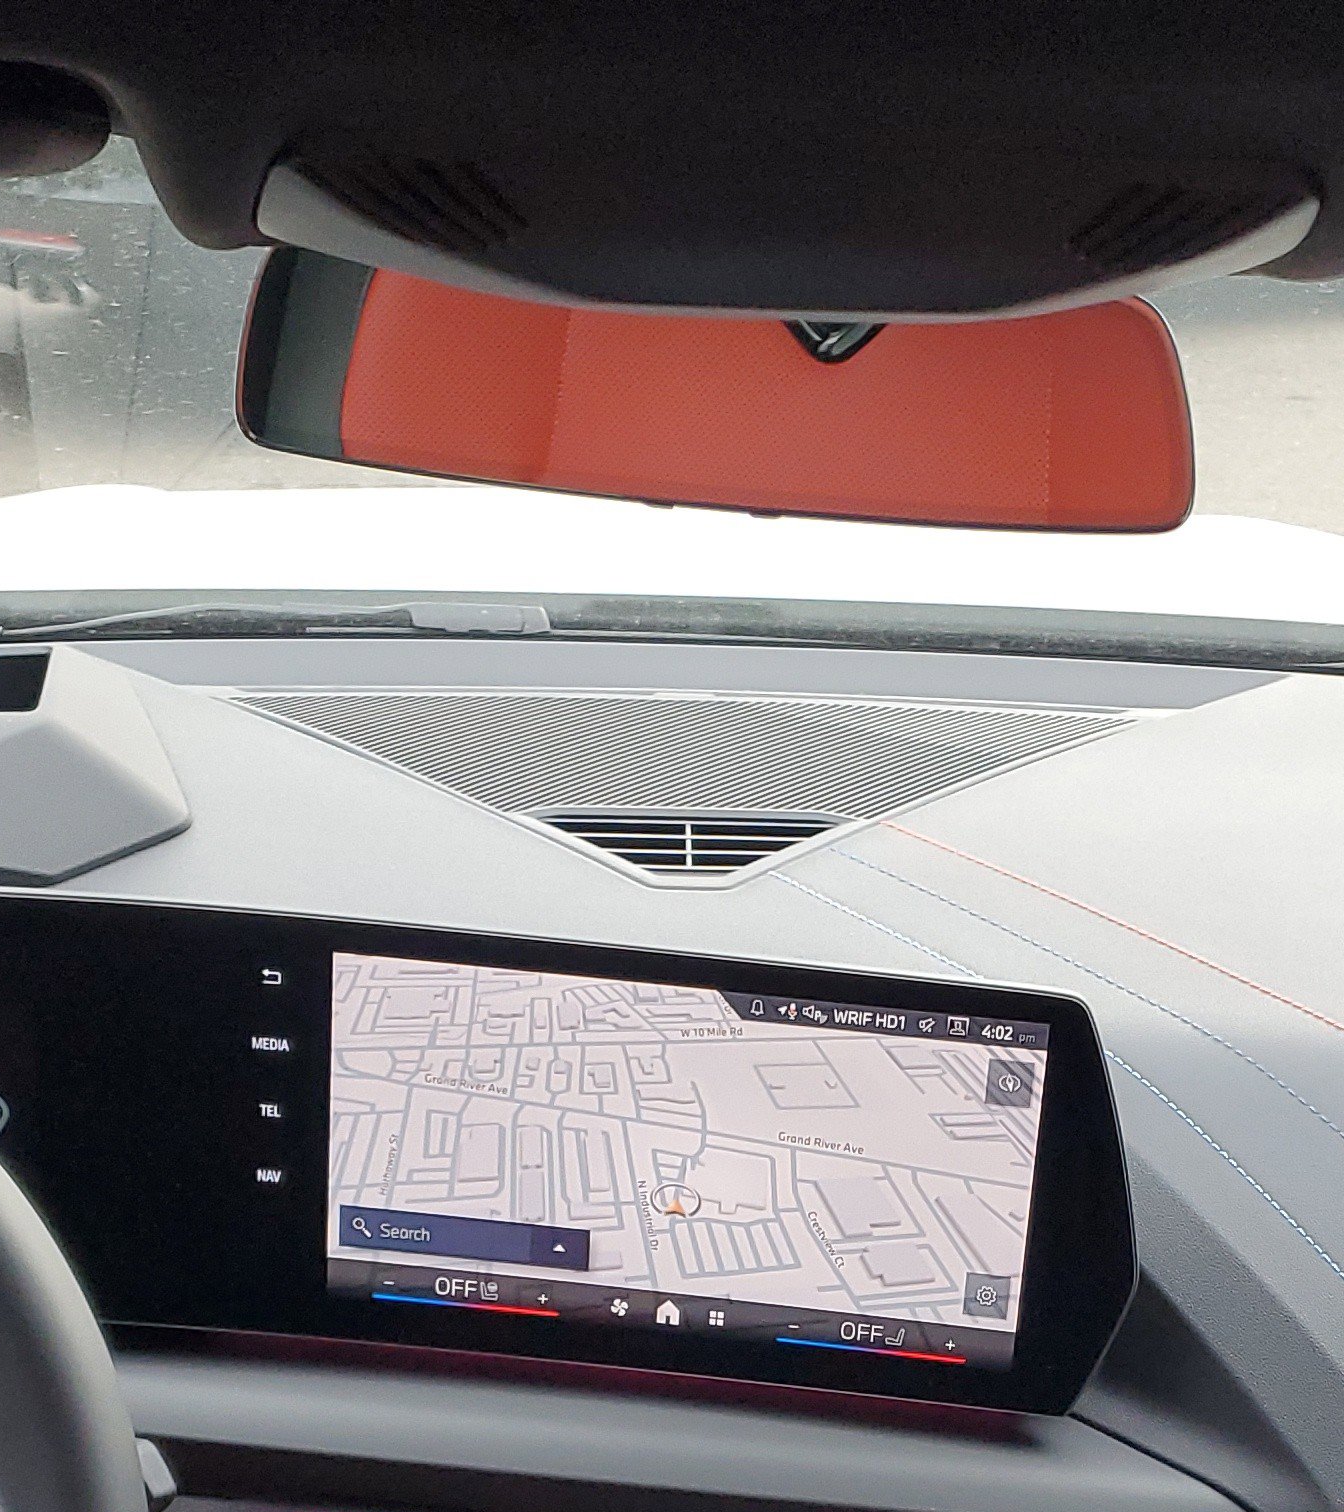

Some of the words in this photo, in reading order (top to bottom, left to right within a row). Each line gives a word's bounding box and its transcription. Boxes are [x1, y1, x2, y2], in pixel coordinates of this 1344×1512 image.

[834, 1009, 873, 1027] WRIF
[876, 1012, 906, 1031] HD1
[681, 1028, 691, 1038] W
[693, 1028, 704, 1037] 10
[708, 1028, 727, 1036] Mile
[730, 1027, 743, 1036] Rd
[982, 1024, 1013, 1041] 4:02
[1019, 1034, 1036, 1044] pm
[251, 1037, 290, 1053] MEDIA
[424, 1073, 456, 1087] Grand
[459, 1080, 486, 1091] River
[488, 1083, 508, 1095] Ave
[259, 1104, 281, 1118] TEL
[778, 1132, 811, 1147] Grand
[813, 1137, 842, 1150] River
[840, 1142, 865, 1156] Ave
[257, 1169, 282, 1184] NAV
[638, 1180, 646, 1189] N
[639, 1192, 656, 1235] Industrial
[379, 1224, 431, 1243] Search
[807, 1211, 837, 1257] Crestview
[834, 1256, 846, 1269] Ct
[650, 1239, 659, 1251] Dr
[434, 1277, 477, 1298] OFF
[840, 1322, 884, 1342] OFF
